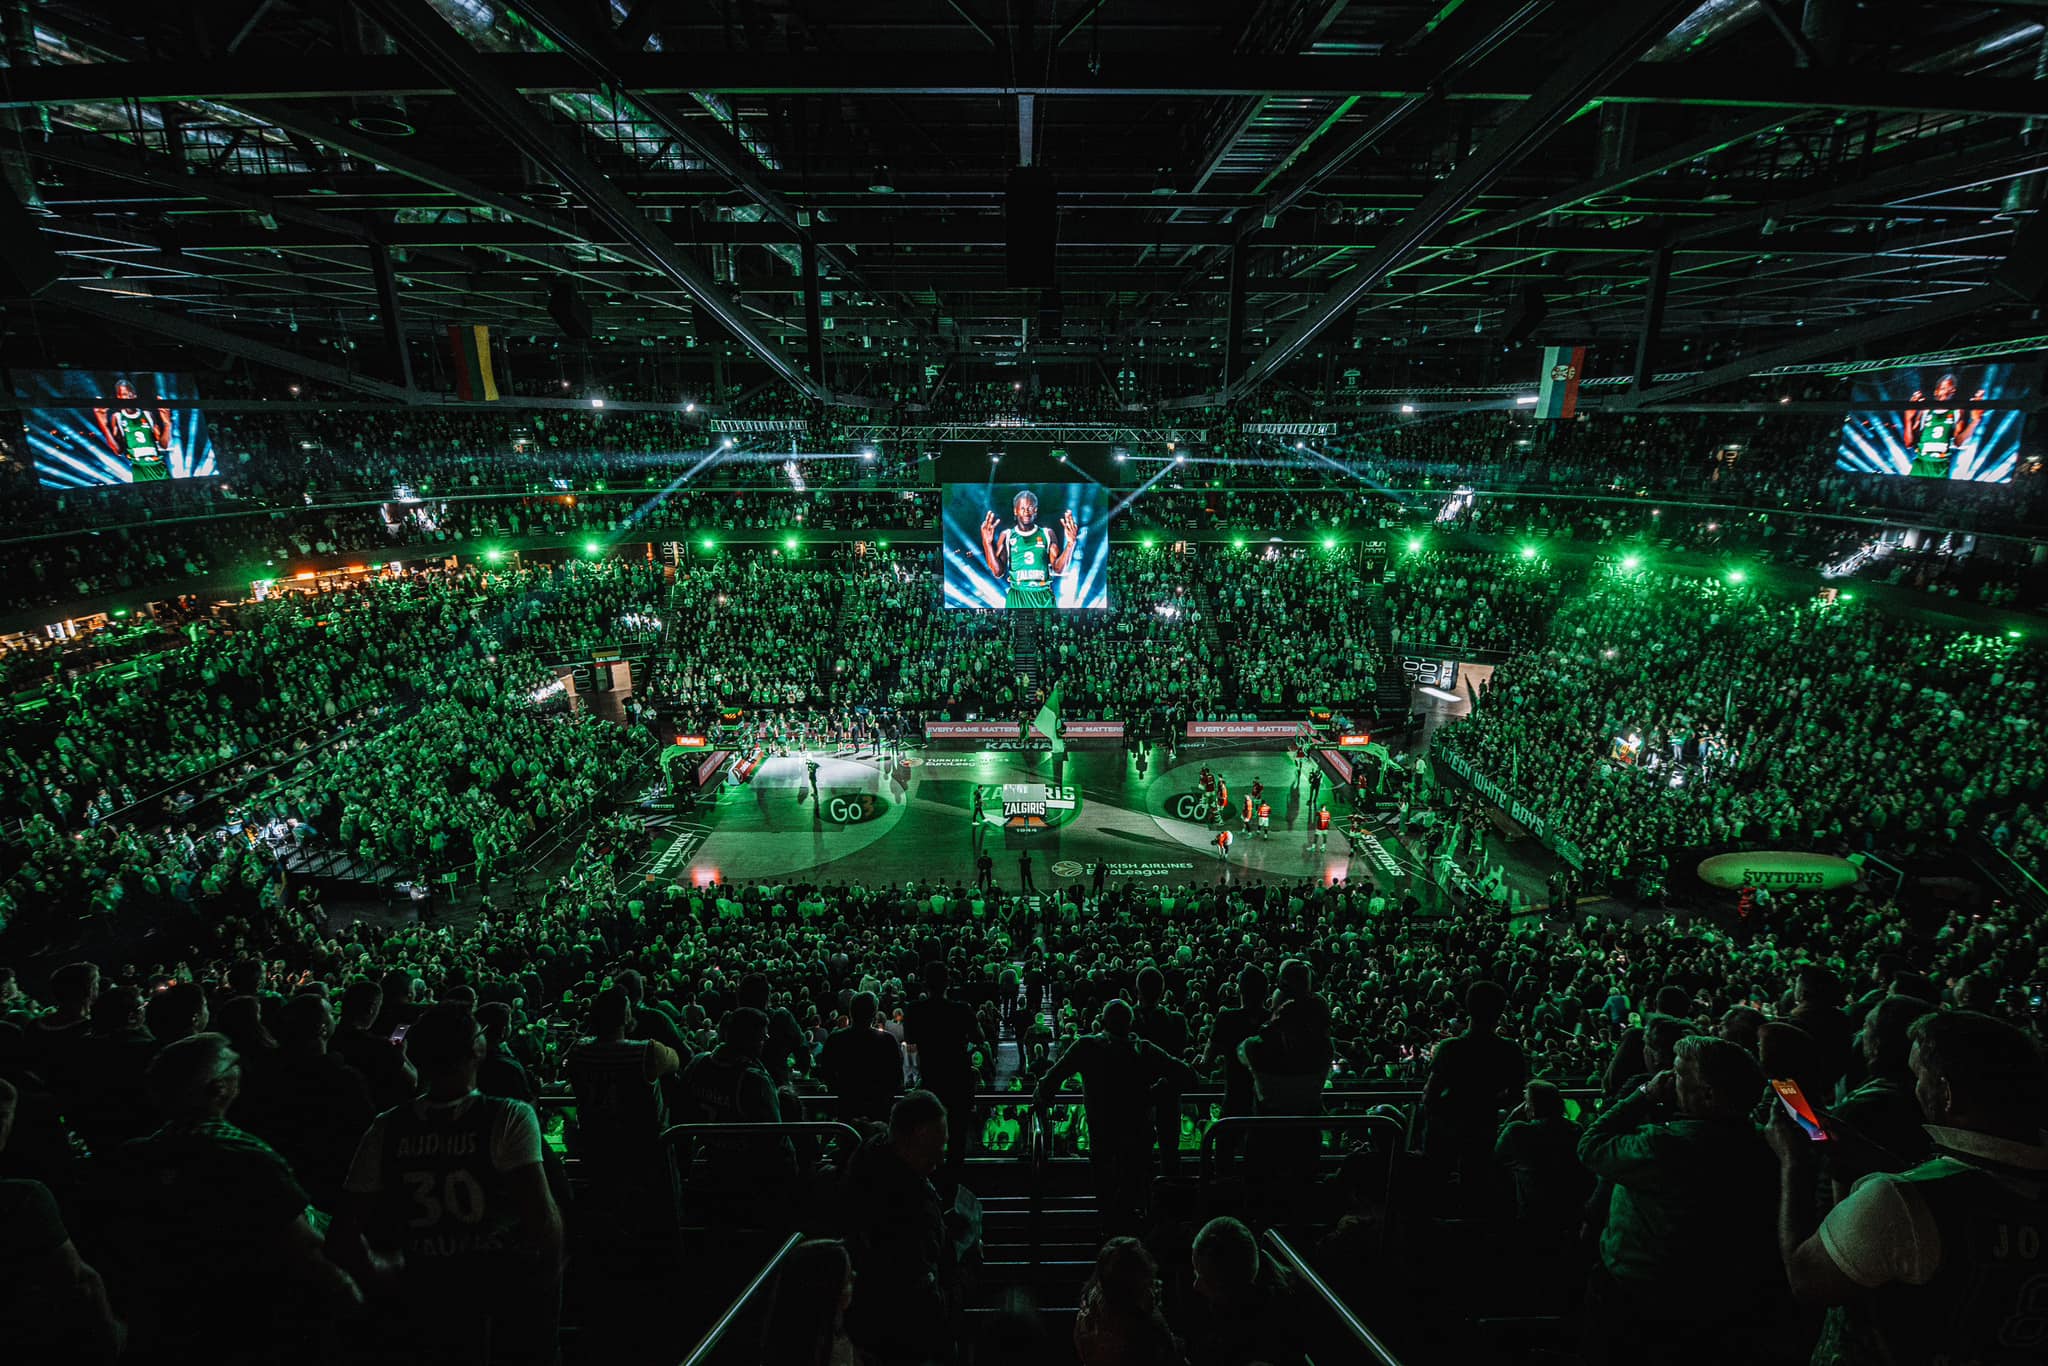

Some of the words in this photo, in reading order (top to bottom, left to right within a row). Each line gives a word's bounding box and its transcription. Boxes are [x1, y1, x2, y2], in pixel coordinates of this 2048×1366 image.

[1024, 551, 1035, 565] 3
[1004, 802, 1046, 816] ZALGIRIS
[1474, 771, 1508, 809] WHITE
[1511, 800, 1545, 838] BOYS
[1743, 868, 1825, 884] ŠVYTURYS
[402, 1168, 487, 1228] 30
